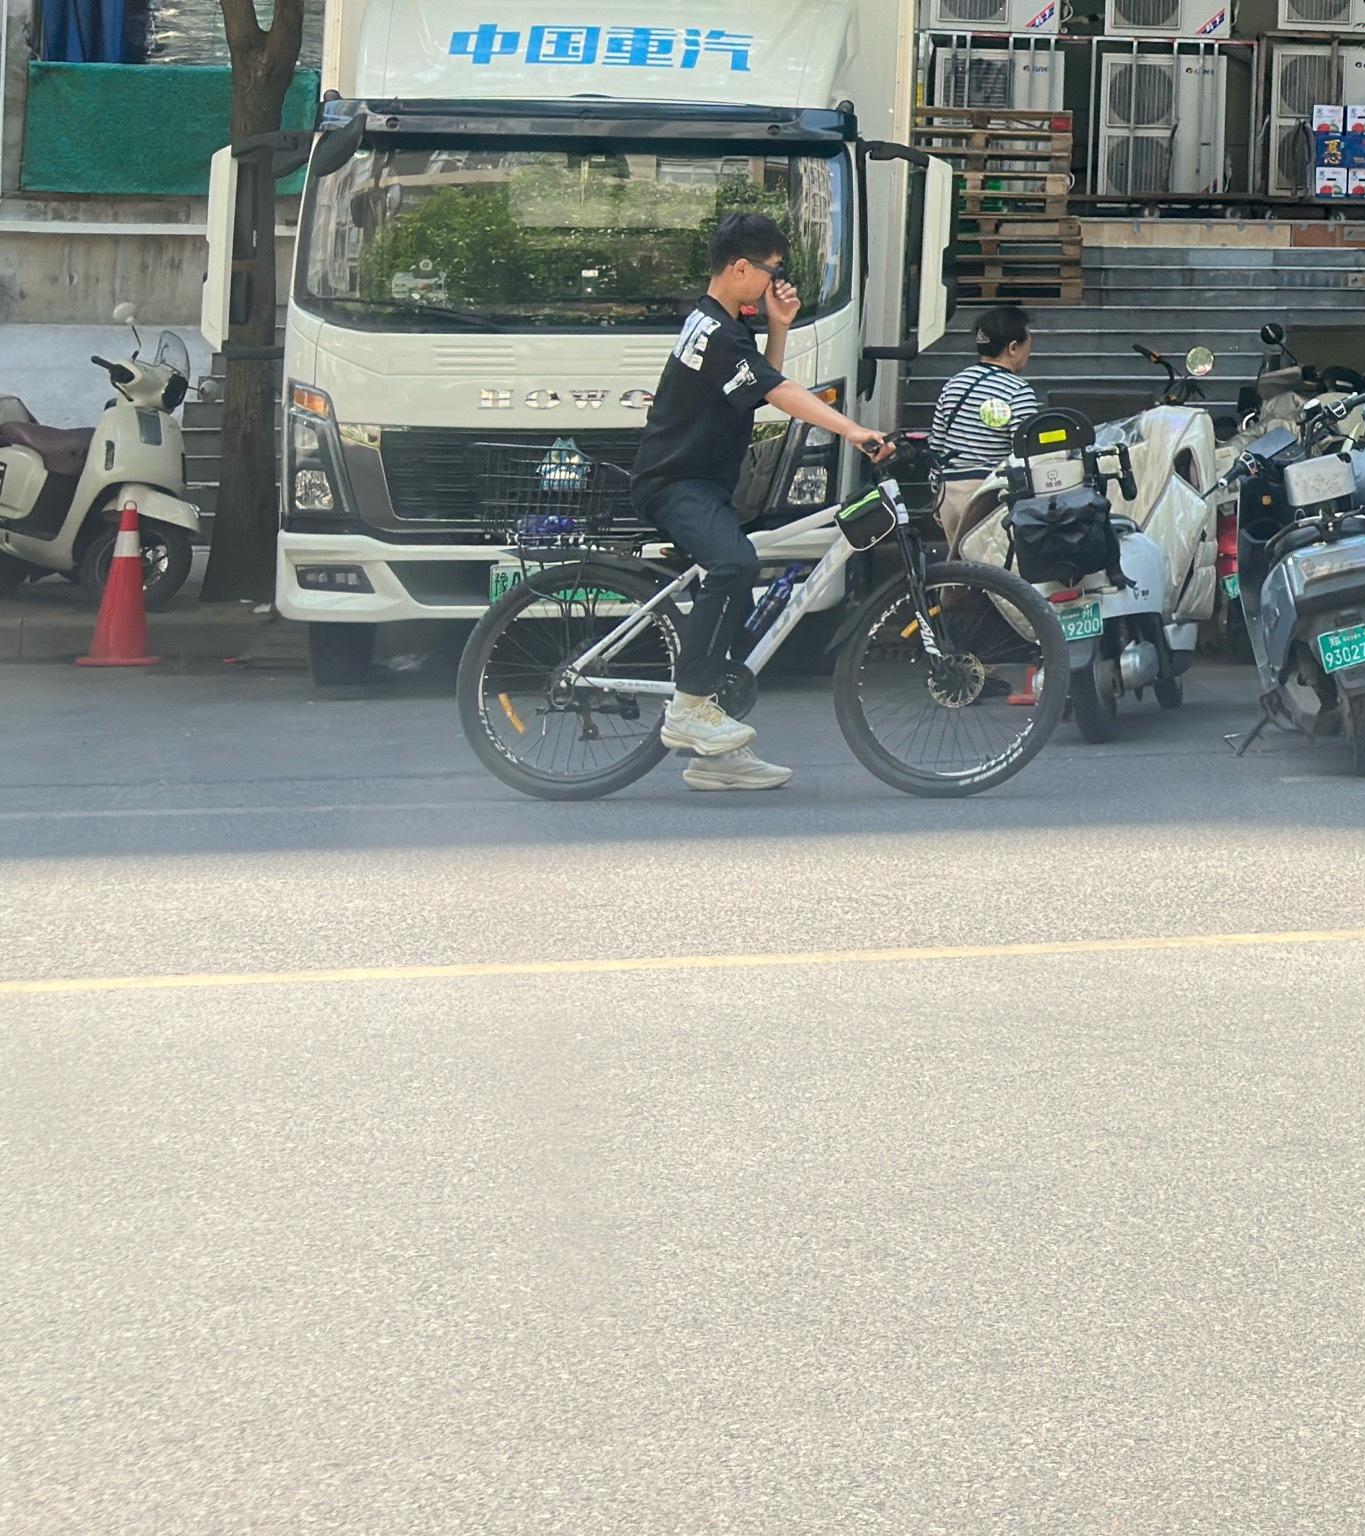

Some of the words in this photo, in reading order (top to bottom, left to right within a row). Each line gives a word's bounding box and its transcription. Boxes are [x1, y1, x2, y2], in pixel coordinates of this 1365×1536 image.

[449, 24, 754, 72] 中国重汽
[477, 389, 654, 410] HOWO
